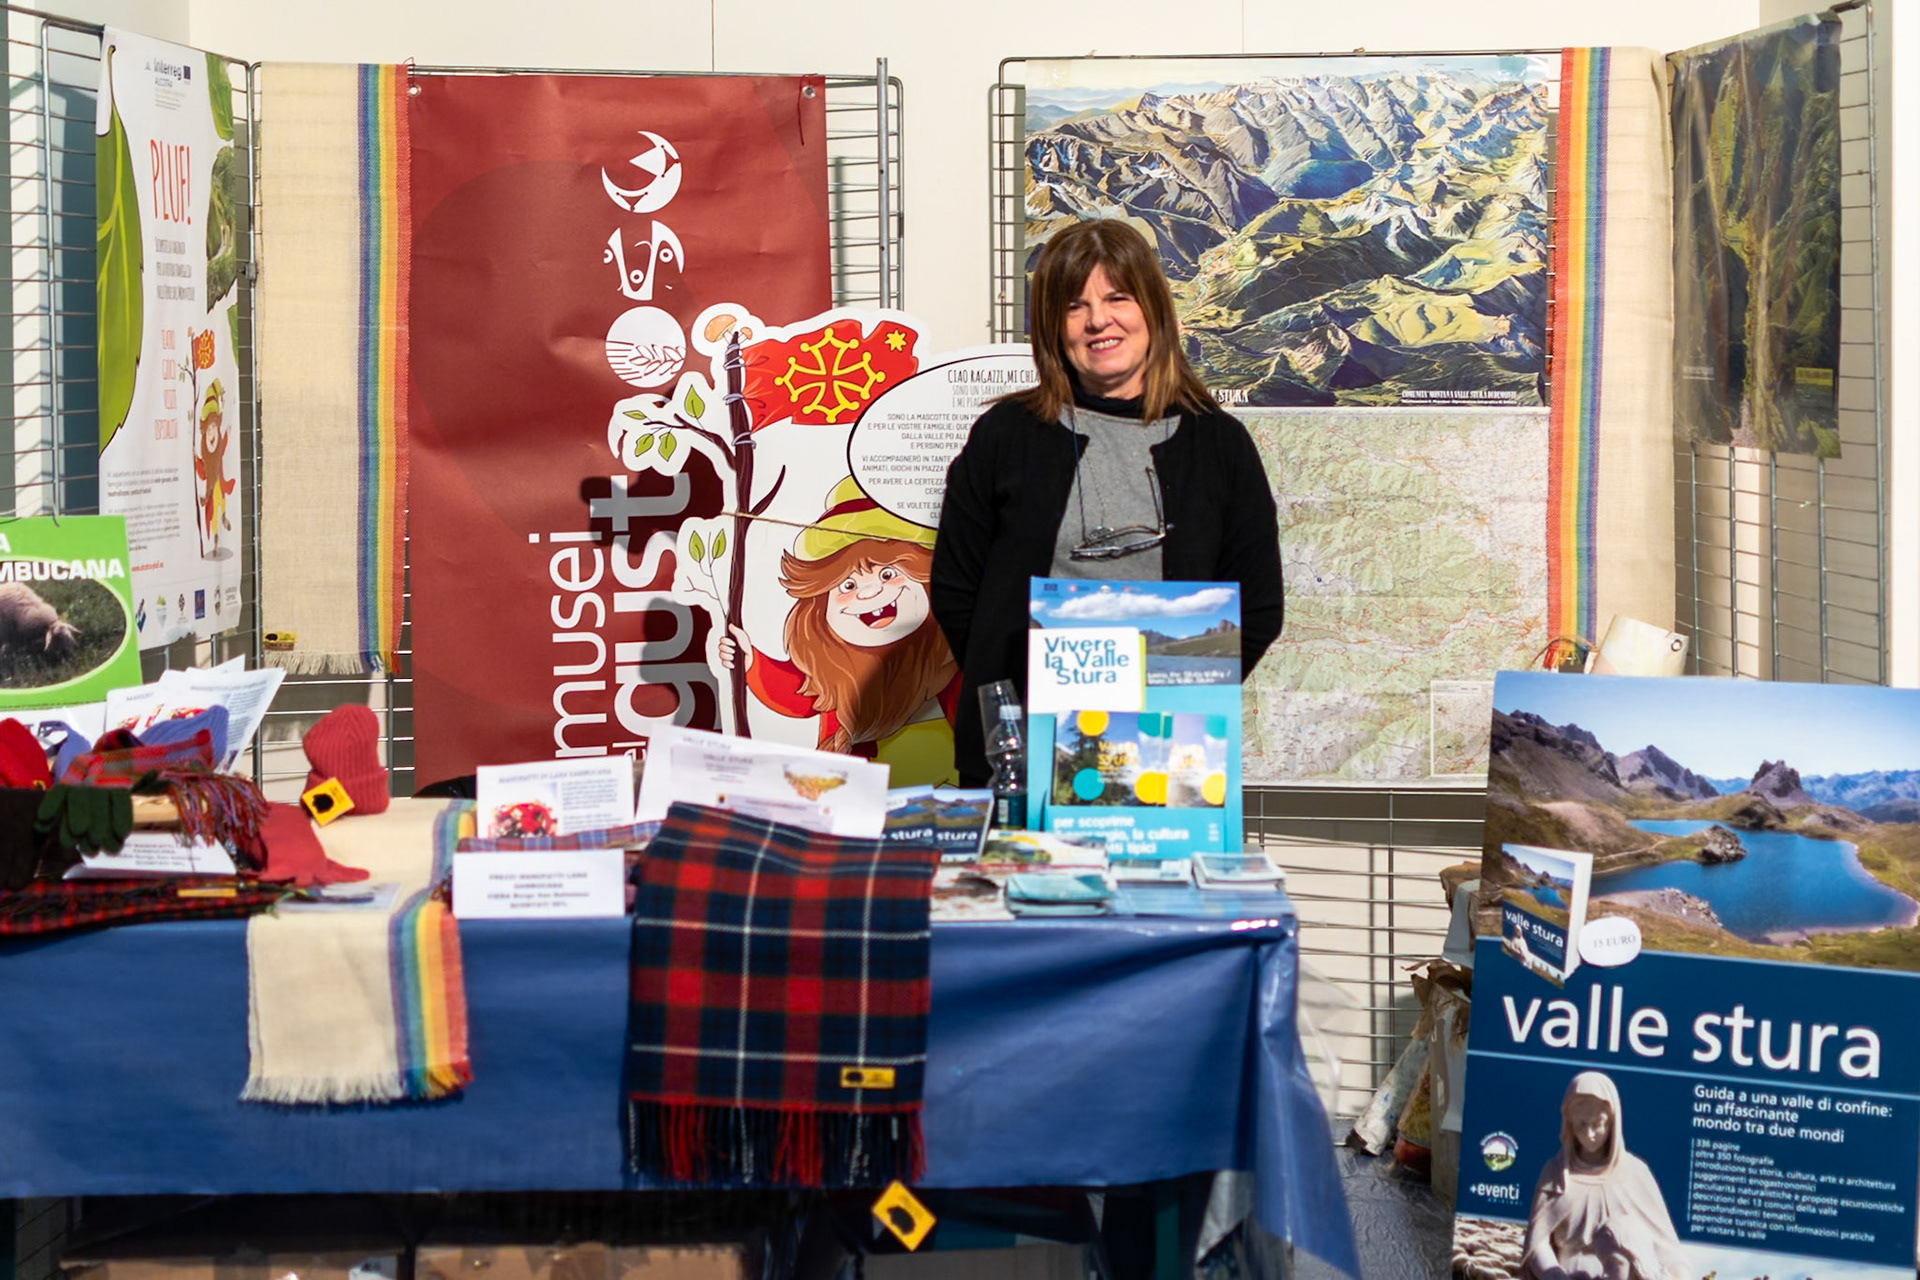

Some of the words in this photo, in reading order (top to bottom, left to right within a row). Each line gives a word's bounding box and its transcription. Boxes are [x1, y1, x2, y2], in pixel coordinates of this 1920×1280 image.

[150, 139, 192, 225] PLUF!
[948, 370, 968, 383] CIAO
[1020, 370, 1040, 383] CHIA
[528, 531, 608, 759] musei
[1044, 636, 1117, 654] Vivere
[1044, 652, 1064, 670] la
[1074, 650, 1130, 668] Valle
[1056, 668, 1118, 686] Stura
[1053, 818, 1074, 829] per
[890, 829, 934, 840] stura
[937, 832, 978, 841] stura
[1148, 828, 1190, 840] cultura
[1505, 910, 1530, 930] valle
[1532, 923, 1564, 948] stura
[1606, 934, 1636, 946] EURO
[1502, 984, 1668, 1058] valle
[1692, 1004, 1881, 1079] stura
[1694, 1084, 1735, 1100] Guida
[1738, 1092, 1747, 1102] a
[1751, 1093, 1777, 1105] una
[1782, 1095, 1814, 1109] valle
[1818, 1098, 1831, 1111] di
[1836, 1101, 1892, 1117] confine:
[1694, 1102, 1711, 1114] un
[1715, 1103, 1799, 1123] affascinante
[1693, 1116, 1740, 1131] mondo
[1745, 1122, 1764, 1134] tra
[1769, 1123, 1795, 1138] due
[1800, 1127, 1845, 1143] mondi
[1712, 1141, 1740, 1151] pagine
[1695, 1150, 1714, 1159] oltre
[1717, 1152, 1732, 1161] 350
[1733, 1154, 1774, 1166] fotografie
[1694, 1161, 1746, 1173] introduzione
[1759, 1167, 1784, 1178] storia,
[1786, 1170, 1818, 1182] cultura,
[1820, 1175, 1837, 1183] arte
[1846, 1178, 1896, 1190] architettura
[1694, 1171, 1747, 1183] suggerimenti
[1749, 1178, 1816, 1192] enogastronomici
[1693, 1183, 1736, 1193] peculiarità
[1737, 1187, 1792, 1200] naturalistiche
[1802, 1194, 1838, 1206] proposte
[1840, 1200, 1905, 1213] escursionistiche
[1693, 1192, 1735, 1203] descrizioni
[1737, 1197, 1750, 1205] dei
[1764, 1201, 1794, 1210] comuni
[1796, 1204, 1816, 1213] della
[1818, 1207, 1838, 1216] valle
[1692, 1204, 1761, 1217] approfondimenti
[1763, 1211, 1796, 1222] tematici
[1692, 1214, 1733, 1225] appendice
[1735, 1219, 1767, 1229] turistica
[1786, 1225, 1839, 1237] informazioni
[1840, 1231, 1875, 1243] pratiche
[1706, 1226, 1735, 1236] visitare
[1737, 1229, 1745, 1237] la
[1747, 1231, 1766, 1240] valle
